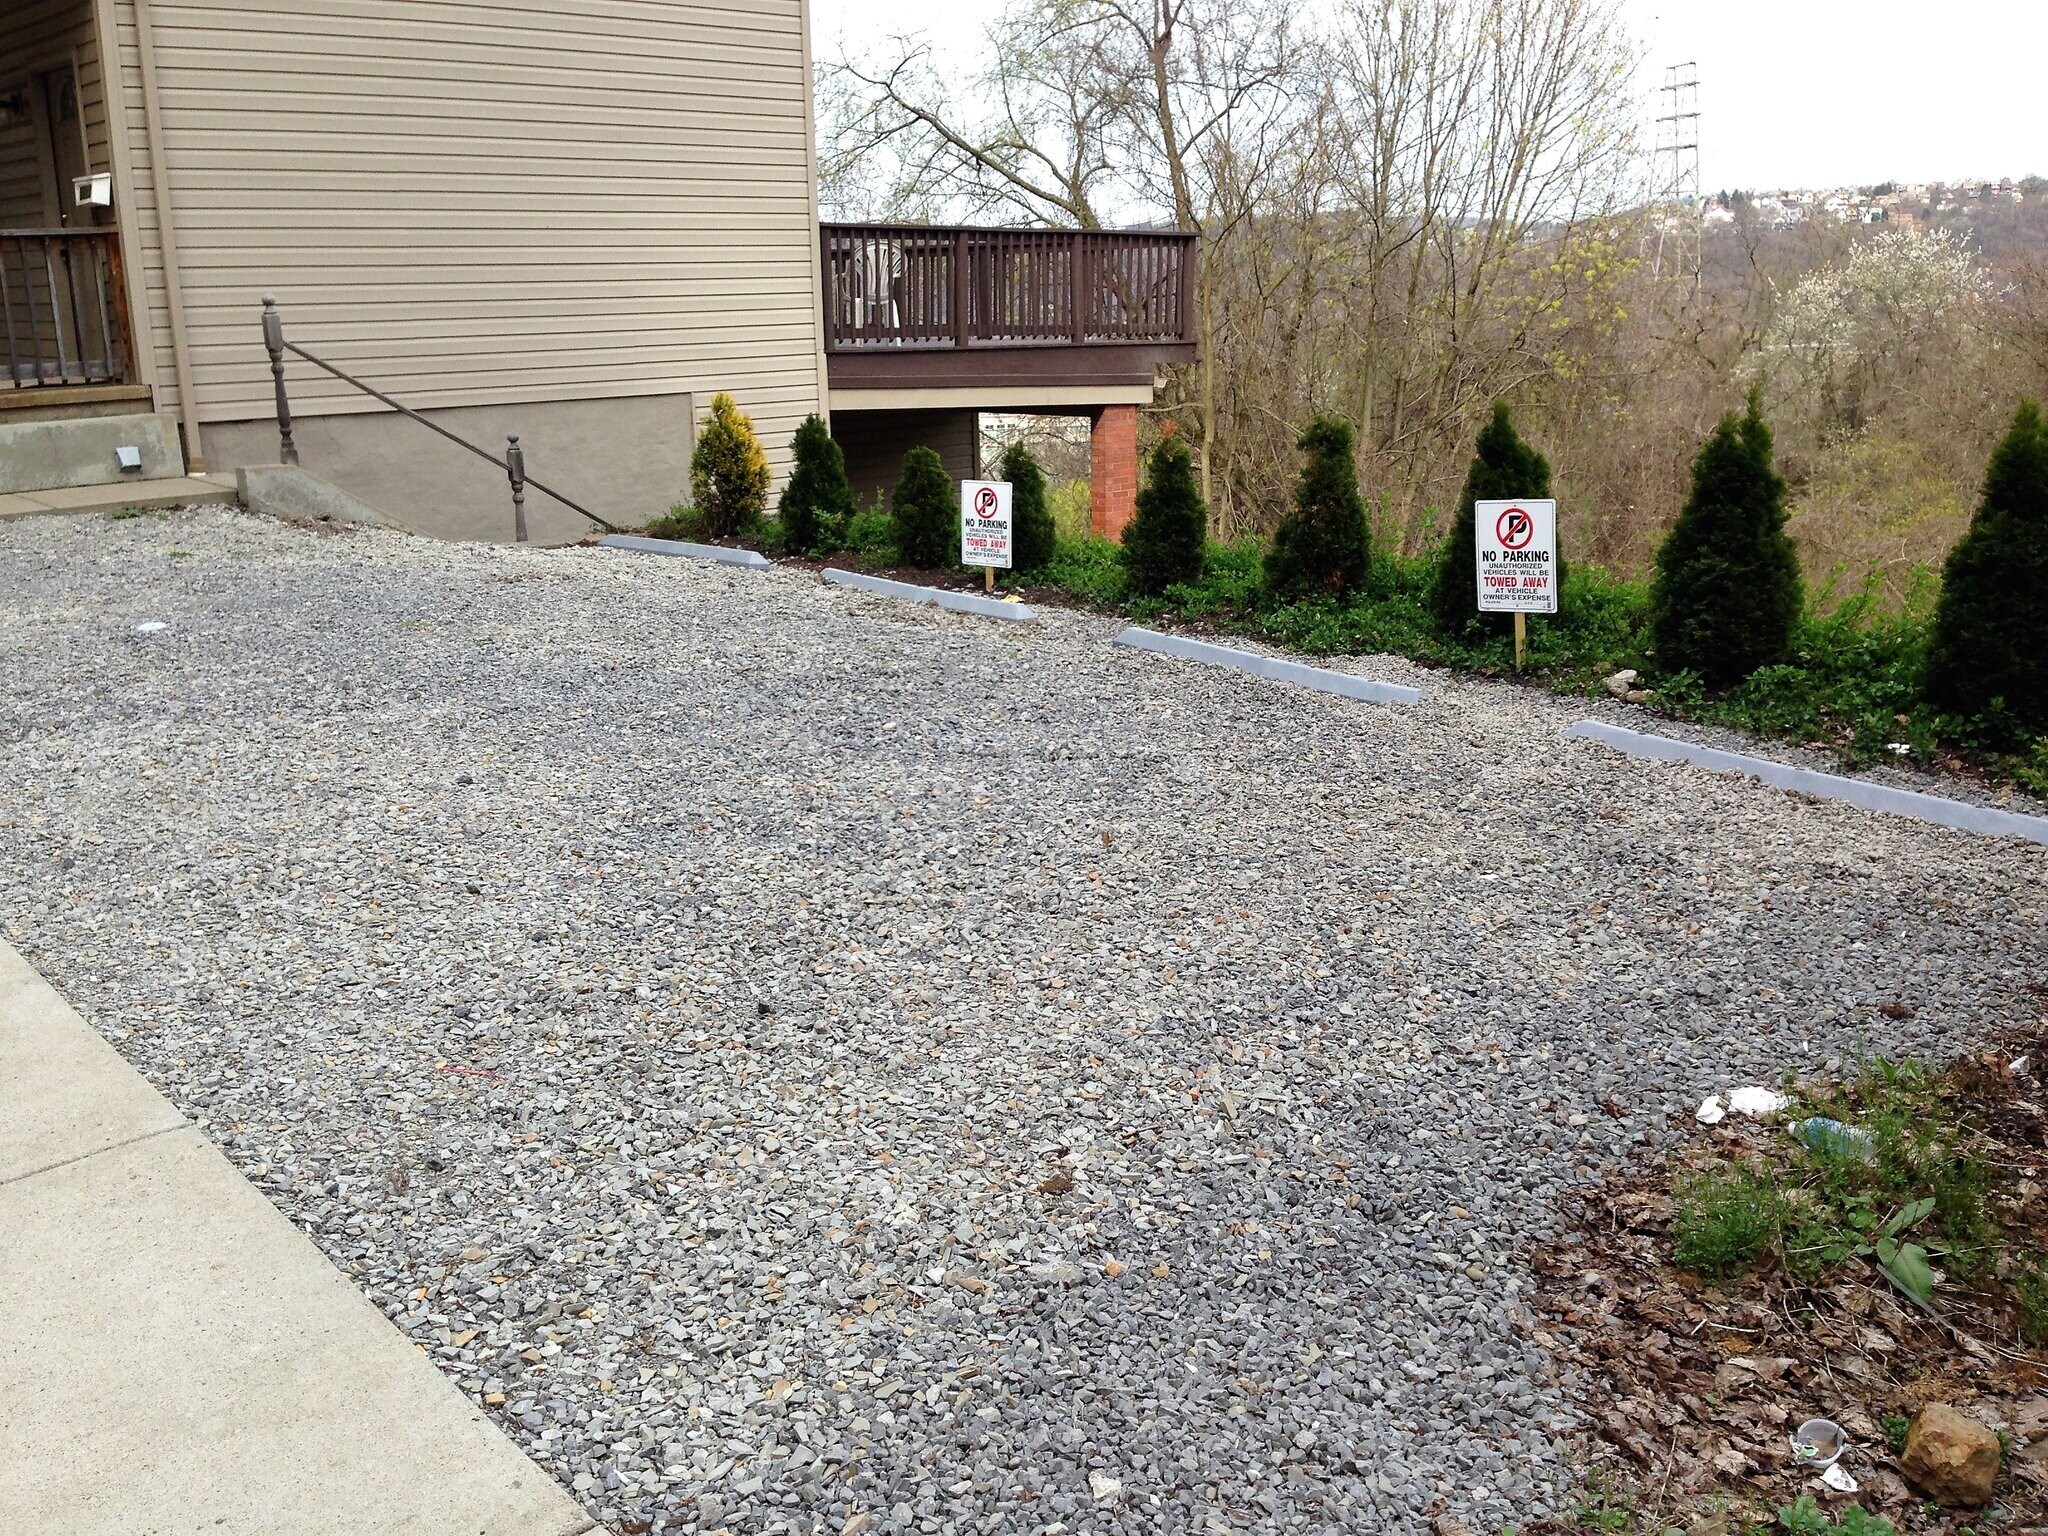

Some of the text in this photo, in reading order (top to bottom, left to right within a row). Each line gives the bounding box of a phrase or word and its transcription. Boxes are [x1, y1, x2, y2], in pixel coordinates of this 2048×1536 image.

[966, 518, 1007, 529] NO PARKING
[966, 538, 1007, 549] TOWED AWAY
[1483, 551, 1549, 562] NO PARKING
[1484, 577, 1548, 587] TOWED AWAY
